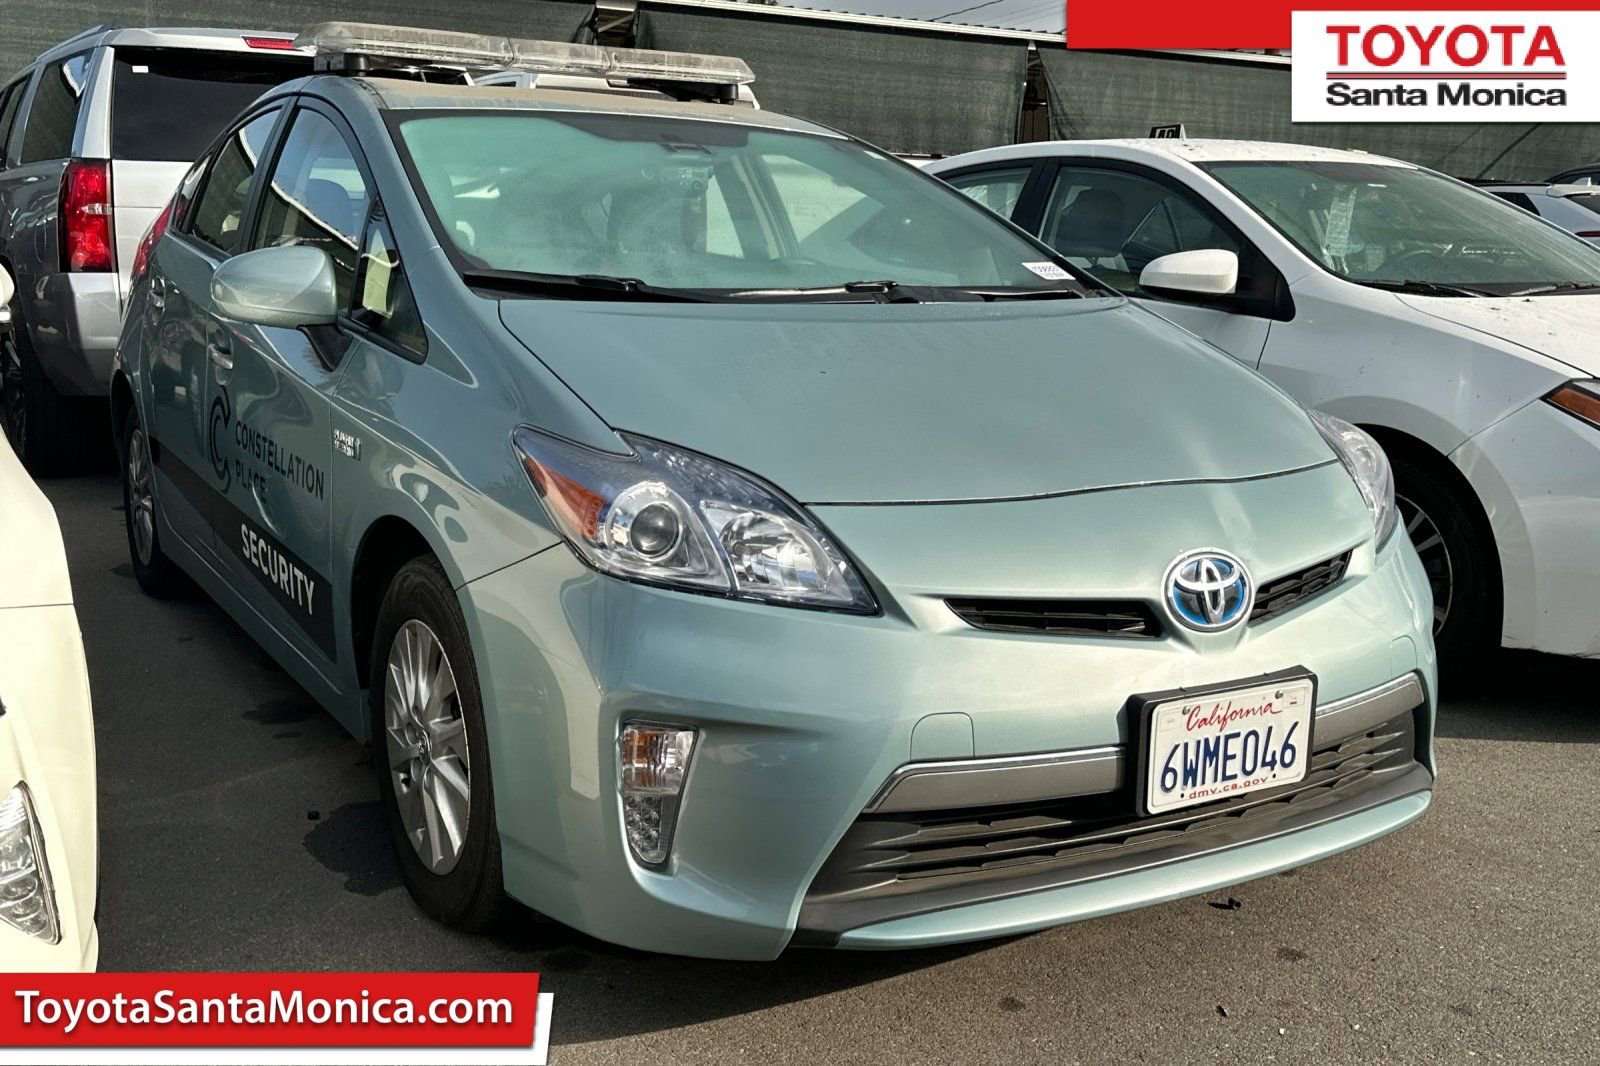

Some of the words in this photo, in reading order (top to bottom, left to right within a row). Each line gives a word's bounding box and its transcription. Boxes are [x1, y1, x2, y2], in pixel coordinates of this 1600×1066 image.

[235, 420, 324, 500] CONSTELLATION
[236, 459, 266, 503] PLACE
[241, 523, 315, 615] SECURITY
[1186, 701, 1282, 732] California
[1161, 721, 1299, 793] 6WME046
[1189, 776, 1269, 800] dmv.ca.gov
